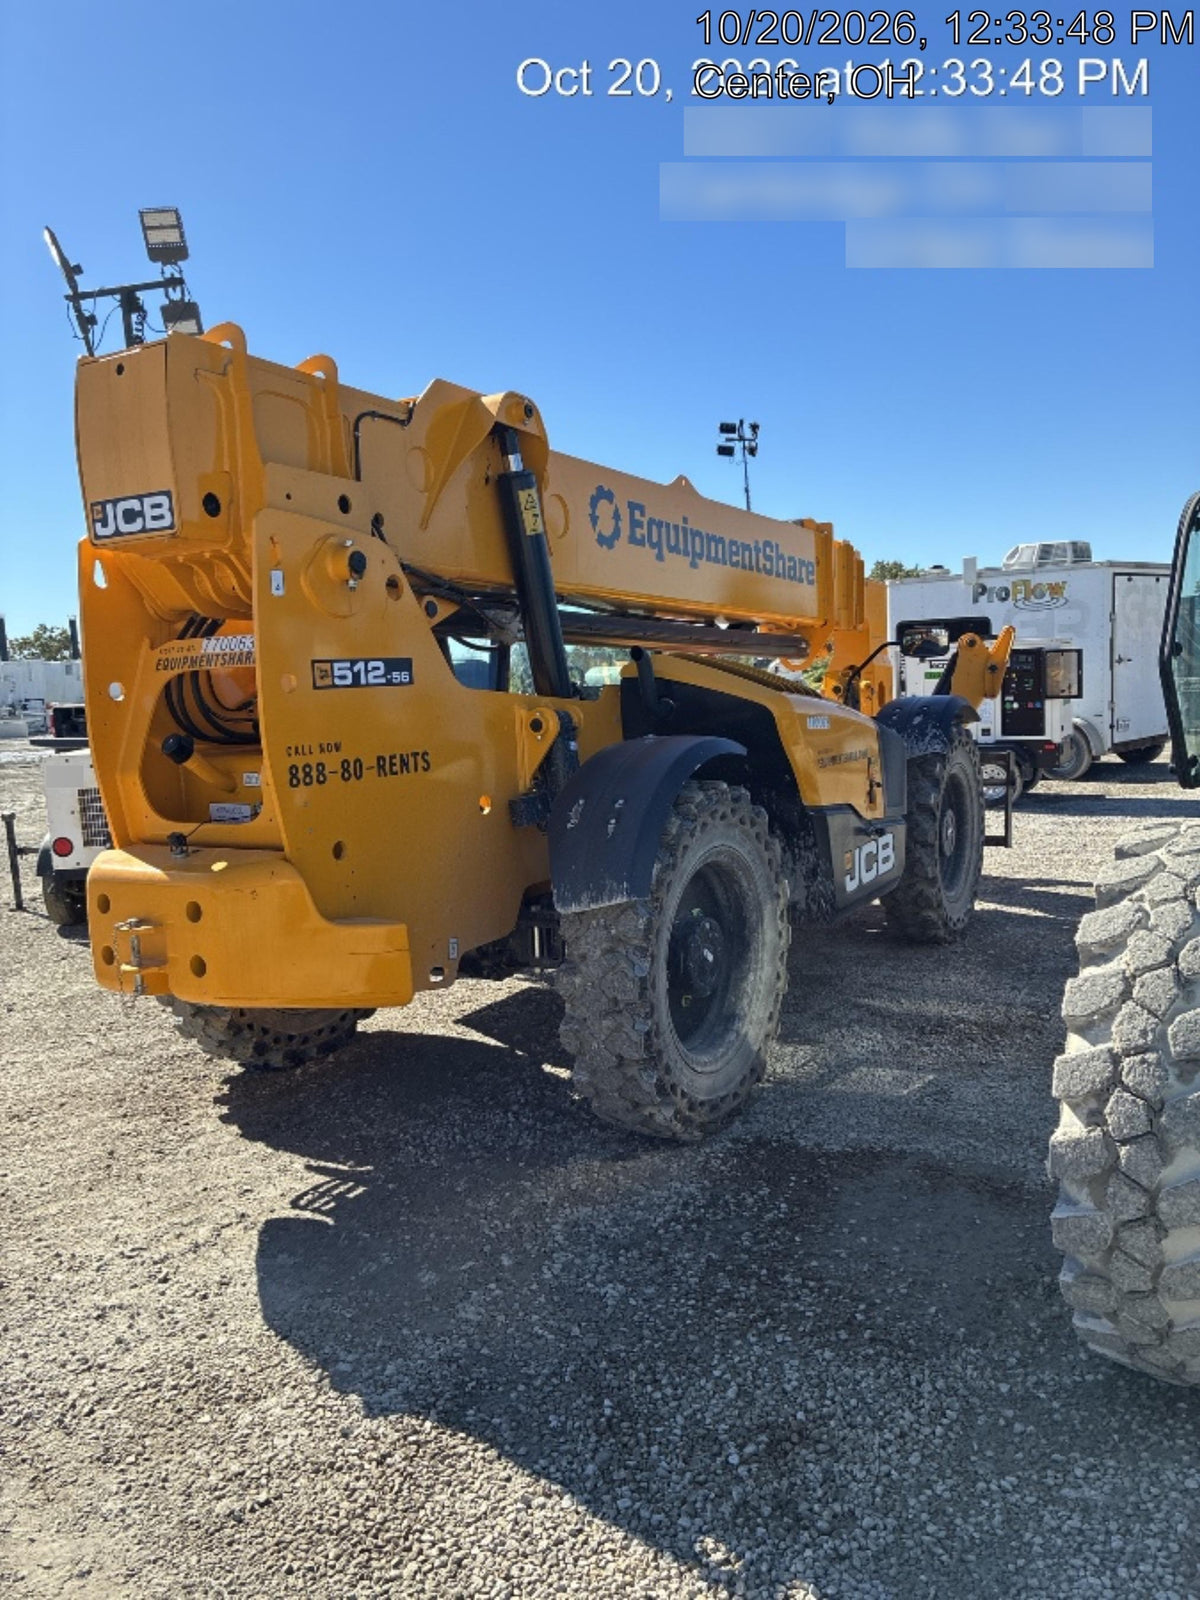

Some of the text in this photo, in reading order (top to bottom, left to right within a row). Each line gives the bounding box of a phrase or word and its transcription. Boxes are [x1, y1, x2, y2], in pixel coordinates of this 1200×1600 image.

[94, 495, 173, 537] JCB
[627, 501, 815, 586] EquipmentShare
[972, 579, 1067, 604] ProFlow
[288, 751, 431, 788] 888-80-RENTS
[844, 833, 895, 893] JCB
